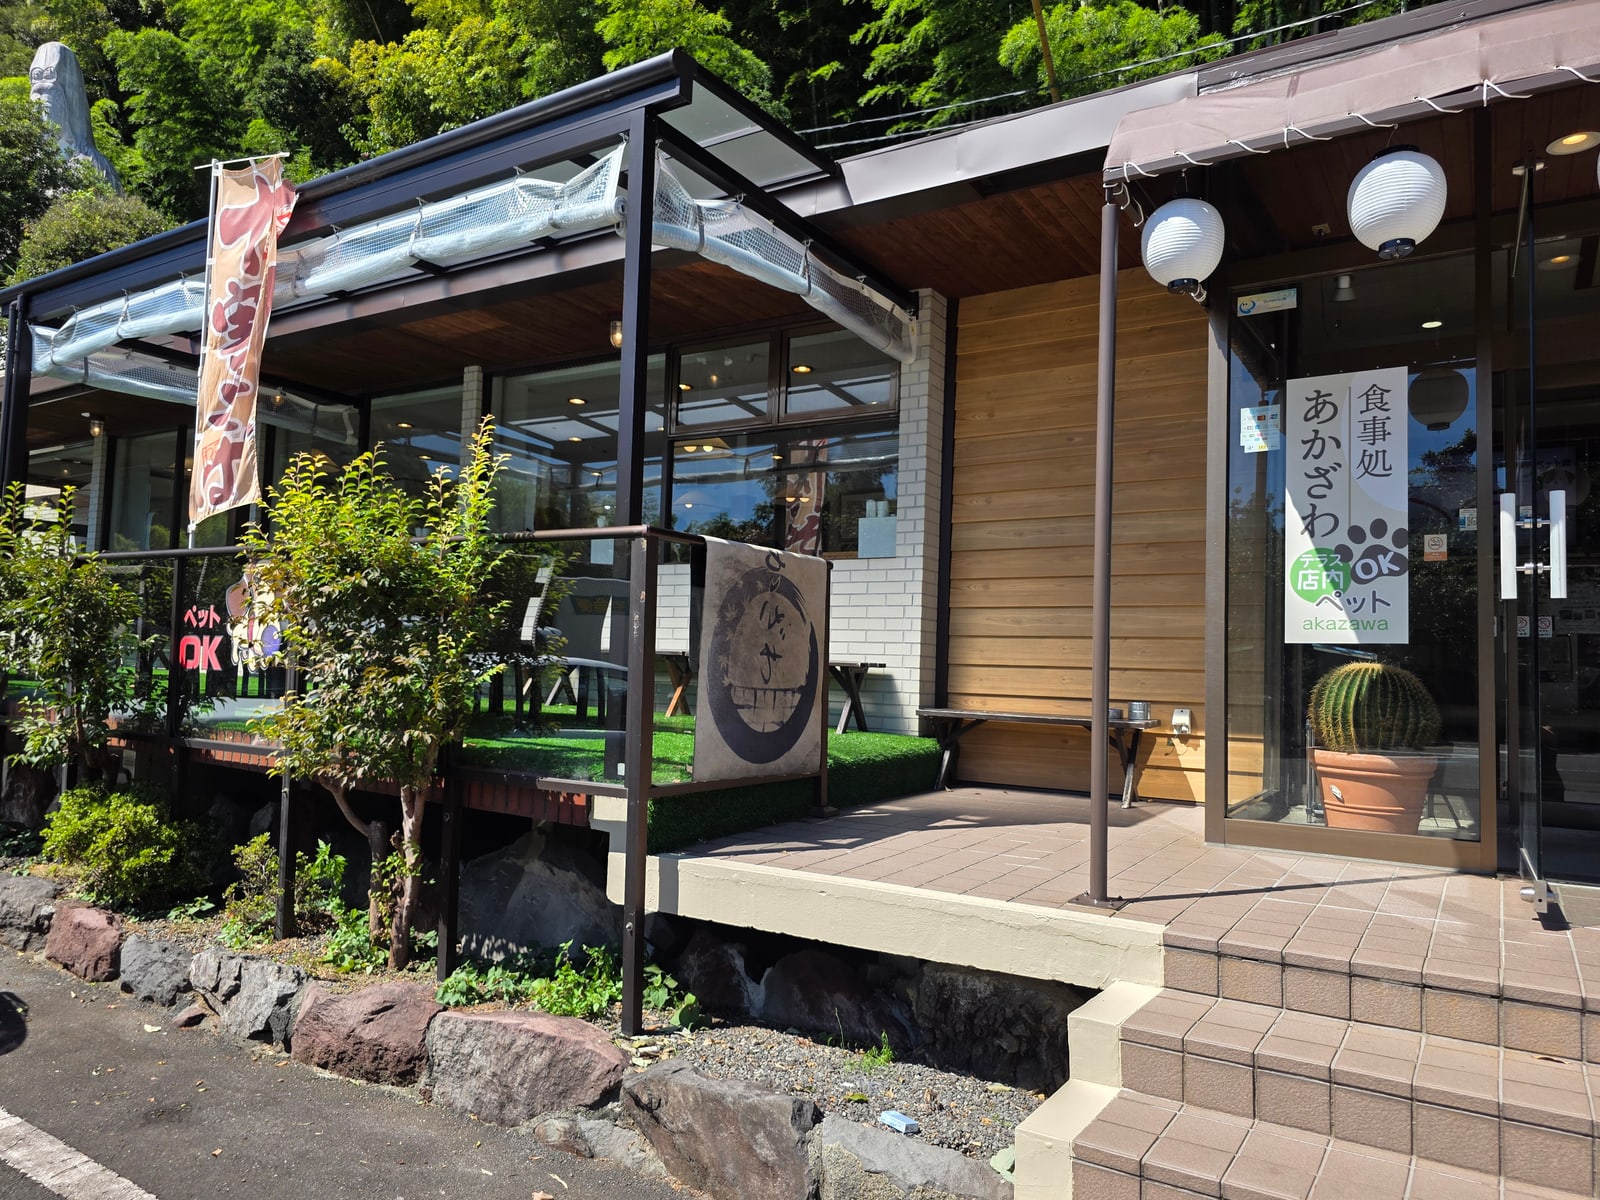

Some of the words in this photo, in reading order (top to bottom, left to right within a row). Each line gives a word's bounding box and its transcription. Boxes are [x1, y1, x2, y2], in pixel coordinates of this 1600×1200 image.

[1356, 383, 1392, 480] 食事処
[1300, 389, 1342, 539] あかざわ
[1300, 553, 1343, 568] テラス
[1355, 551, 1400, 580] OK
[1297, 569, 1344, 590] 店内
[1315, 590, 1391, 613] ペット
[183, 604, 221, 629] ペット
[1302, 616, 1389, 631] akazawa
[179, 635, 223, 671] OK
